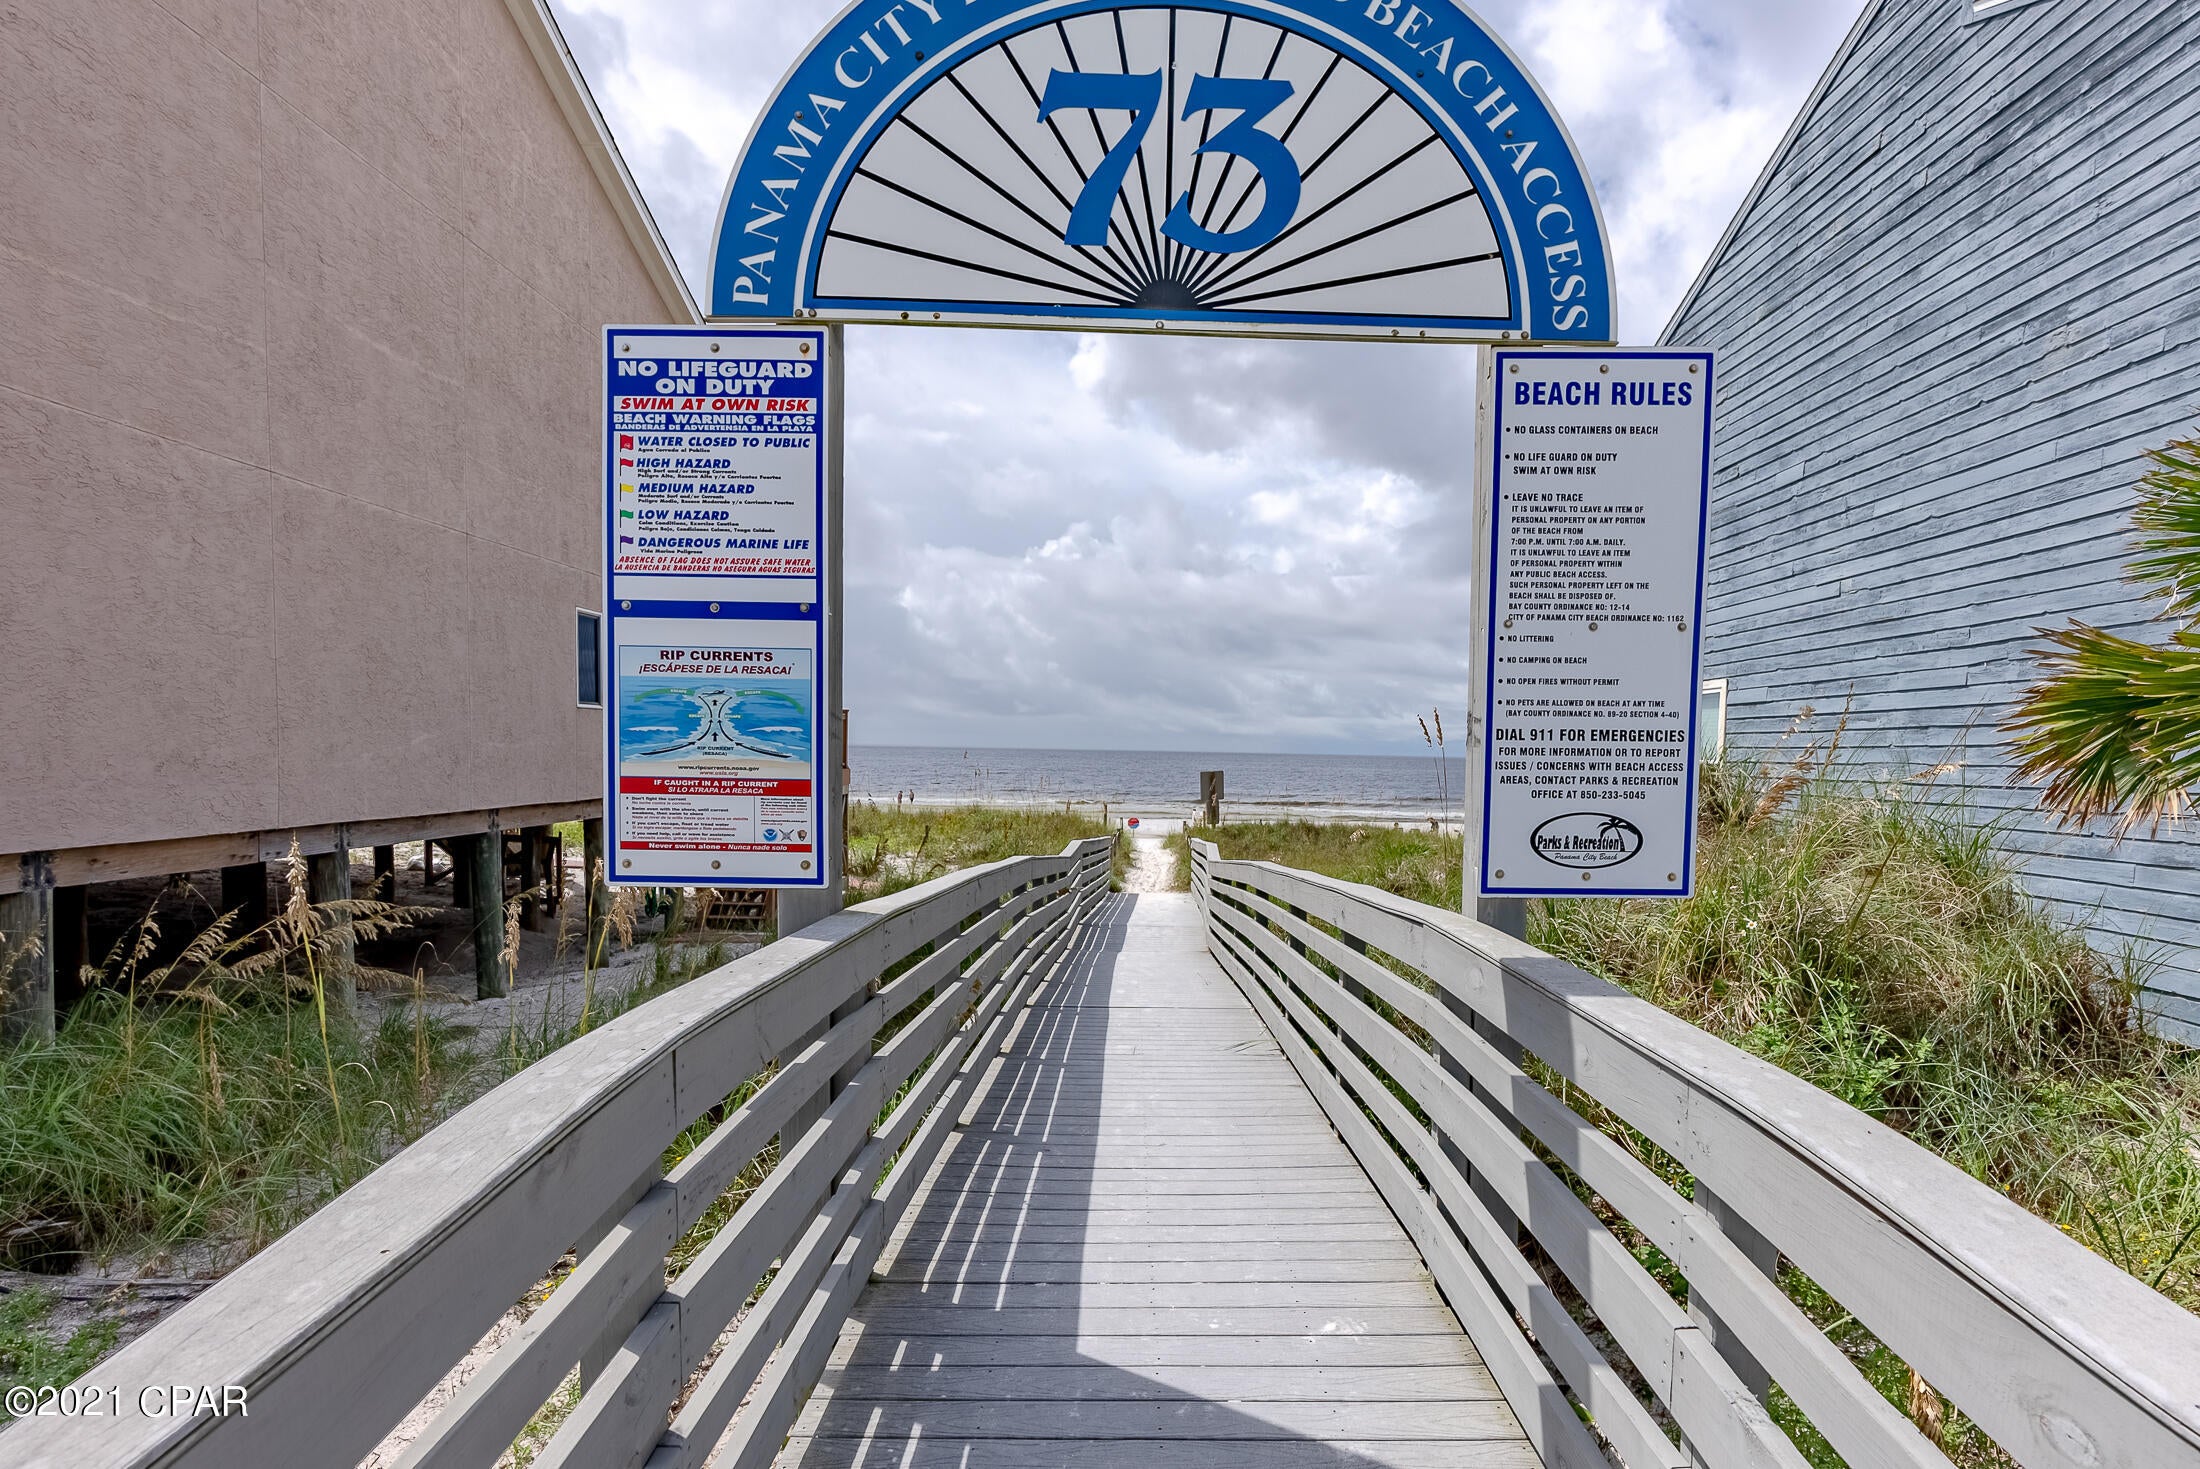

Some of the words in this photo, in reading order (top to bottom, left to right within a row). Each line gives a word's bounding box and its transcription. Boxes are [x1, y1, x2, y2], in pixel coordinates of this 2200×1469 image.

[732, 93, 847, 306] PANAMA
[835, 0, 942, 89] CITY
[1363, 0, 1519, 133] BEACH
[1500, 141, 1588, 332] ACCESS
[1037, 67, 1301, 254] 73
[618, 361, 657, 377] NO
[668, 362, 813, 378] LIFEGUARD
[655, 379, 695, 394] ON
[705, 379, 774, 395] DUTY
[1514, 382, 1600, 406] BEACH
[1611, 382, 1693, 406] RULES
[620, 398, 675, 411] SWIM
[680, 398, 706, 411] AT
[710, 398, 760, 411] OWN
[764, 399, 810, 411] RISK
[614, 414, 666, 424] BEACH
[671, 414, 757, 425] WARNING
[761, 415, 816, 425] FLAGS
[1514, 426, 1526, 435] NO
[1528, 426, 1555, 435] GLASS
[1558, 426, 1612, 435] CONTAINERS
[1614, 426, 1626, 435] ON
[1629, 426, 1659, 435] BEACH
[638, 436, 683, 447] WATER
[687, 437, 738, 448] CLOSED
[740, 437, 760, 448] TO
[763, 438, 811, 448] PUBLIC
[1513, 453, 1525, 462] NO
[1528, 453, 1546, 462] LIFE
[1548, 453, 1577, 462] GUARD
[1580, 453, 1592, 462] ON
[1595, 453, 1618, 462] DUTY
[637, 458, 670, 468] HIGH
[674, 458, 731, 469] HAZARD
[1513, 466, 1537, 475] SWIM
[1540, 466, 1550, 475] AT
[1553, 466, 1573, 475] OWN
[1576, 466, 1596, 475] RISK
[638, 483, 694, 494] MEDIUM
[698, 483, 755, 494] HAZARD
[1512, 493, 1538, 502] LEAVE
[1541, 493, 1552, 502] NO
[1555, 493, 1584, 502] TRACE
[638, 510, 669, 520] LOW
[672, 510, 730, 521] HAZARD
[638, 538, 721, 549] DANGEROUS
[724, 538, 779, 549] MARINE
[782, 539, 810, 550] LIFE
[619, 556, 655, 564] ABSENCE
[656, 556, 667, 564] OF
[668, 556, 688, 565] FLAG
[689, 557, 712, 565] DOES
[712, 557, 729, 565] NOT
[729, 557, 761, 566] ASSURE
[761, 558, 782, 566] SAFE
[783, 558, 812, 567] WATER
[1508, 603, 1522, 611] BAY
[1523, 603, 1551, 611] COUNTY
[1553, 603, 1592, 611] ORDINANCE
[1536, 614, 1566, 622] PANAMA
[1568, 614, 1583, 622] CITY
[1584, 614, 1608, 622] BEACH
[1609, 614, 1650, 622] ORDINANCE
[1519, 635, 1554, 643] LITTERING
[659, 650, 684, 661] RIP
[690, 650, 774, 662] CURRENTS
[1506, 656, 1516, 664] NO
[1518, 656, 1550, 664] CAMPING
[1552, 656, 1562, 664] ON
[1564, 656, 1587, 664] BEACH
[704, 663, 722, 674] DE
[723, 663, 739, 675] LA
[1506, 678, 1516, 686] NO
[1517, 678, 1536, 686] OPEN
[1538, 678, 1557, 686] FIRES
[1559, 678, 1591, 686] WITHOUT
[1592, 678, 1620, 686] PERMIT
[1505, 699, 1516, 707] NO
[1517, 699, 1534, 707] PETS
[1535, 699, 1549, 707] ARE
[1621, 700, 1630, 708] AT
[1632, 700, 1646, 708] ANY
[1647, 700, 1665, 708] TIME
[1505, 710, 1521, 718] (BAY
[1523, 710, 1550, 718] COUNTY
[1552, 710, 1591, 718] ORDINANCE
[1593, 710, 1604, 718] NO.
[1607, 710, 1627, 718] 89-20
[1629, 710, 1658, 719] SECTION
[1660, 711, 1680, 719] 4-40)
[1496, 729, 1524, 741] DIAL
[1530, 729, 1552, 741] 911
[1558, 729, 1585, 742] FOR
[1590, 729, 1685, 742] EMERGENCIES
[653, 779, 662, 787] IF
[664, 779, 699, 787] CAUGHT
[721, 780, 735, 788] RIP
[737, 780, 778, 788] CURRENT
[1499, 775, 1531, 785] AREAS,
[1534, 776, 1576, 785] CONTACT
[1579, 776, 1608, 785] PARKS
[1611, 776, 1618, 786] &
[1621, 776, 1678, 786] RECREATION
[676, 786, 688, 794] LO
[731, 787, 764, 795] RESACA
[1531, 790, 1563, 799] OFFICE
[1565, 790, 1577, 799] AT
[1580, 790, 1646, 800] 850-233-5045
[1536, 834, 1561, 850] Parks
[1563, 835, 1570, 850] &
[1571, 835, 1620, 851] Recreation
[1554, 852, 1581, 860] Panama
[1581, 852, 1598, 860] City
[1597, 853, 1618, 861] Beach
